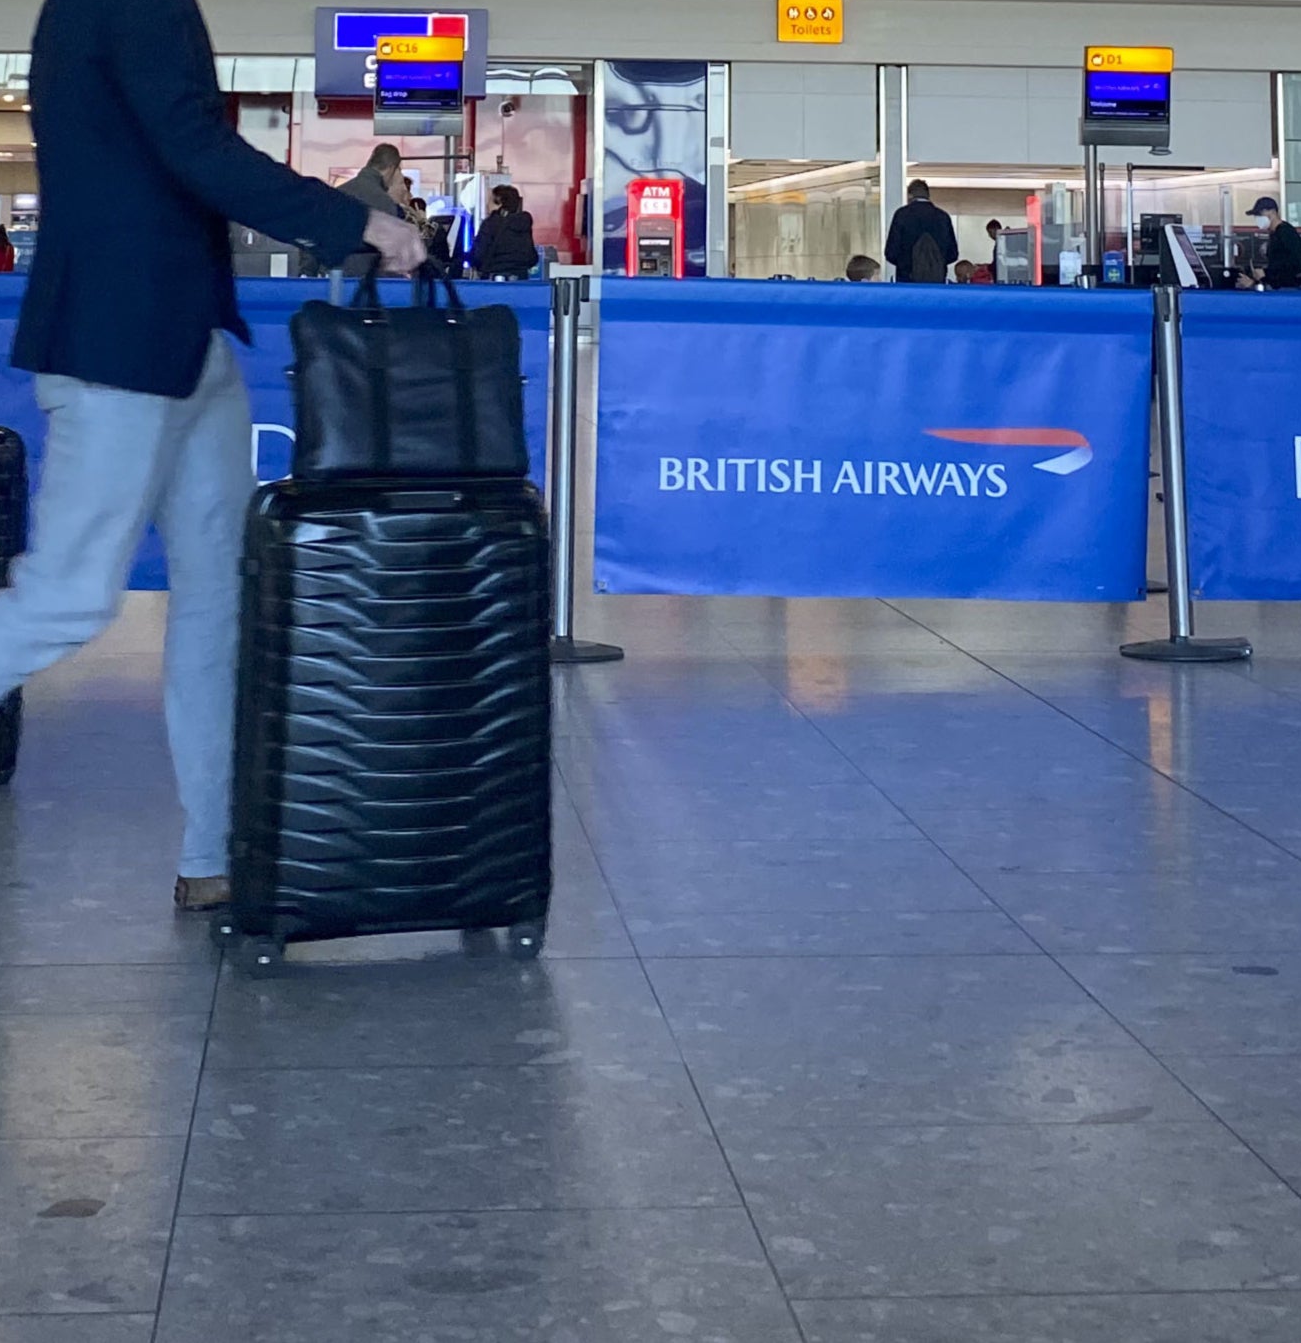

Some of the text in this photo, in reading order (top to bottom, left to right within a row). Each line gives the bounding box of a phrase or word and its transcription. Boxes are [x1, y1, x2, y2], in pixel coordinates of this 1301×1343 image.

[791, 24, 831, 35] Toilets
[396, 43, 418, 54] C16
[1107, 55, 1122, 65] D1
[642, 186, 671, 197] ATM
[658, 457, 1009, 498] BRITISH AIRWAYS
